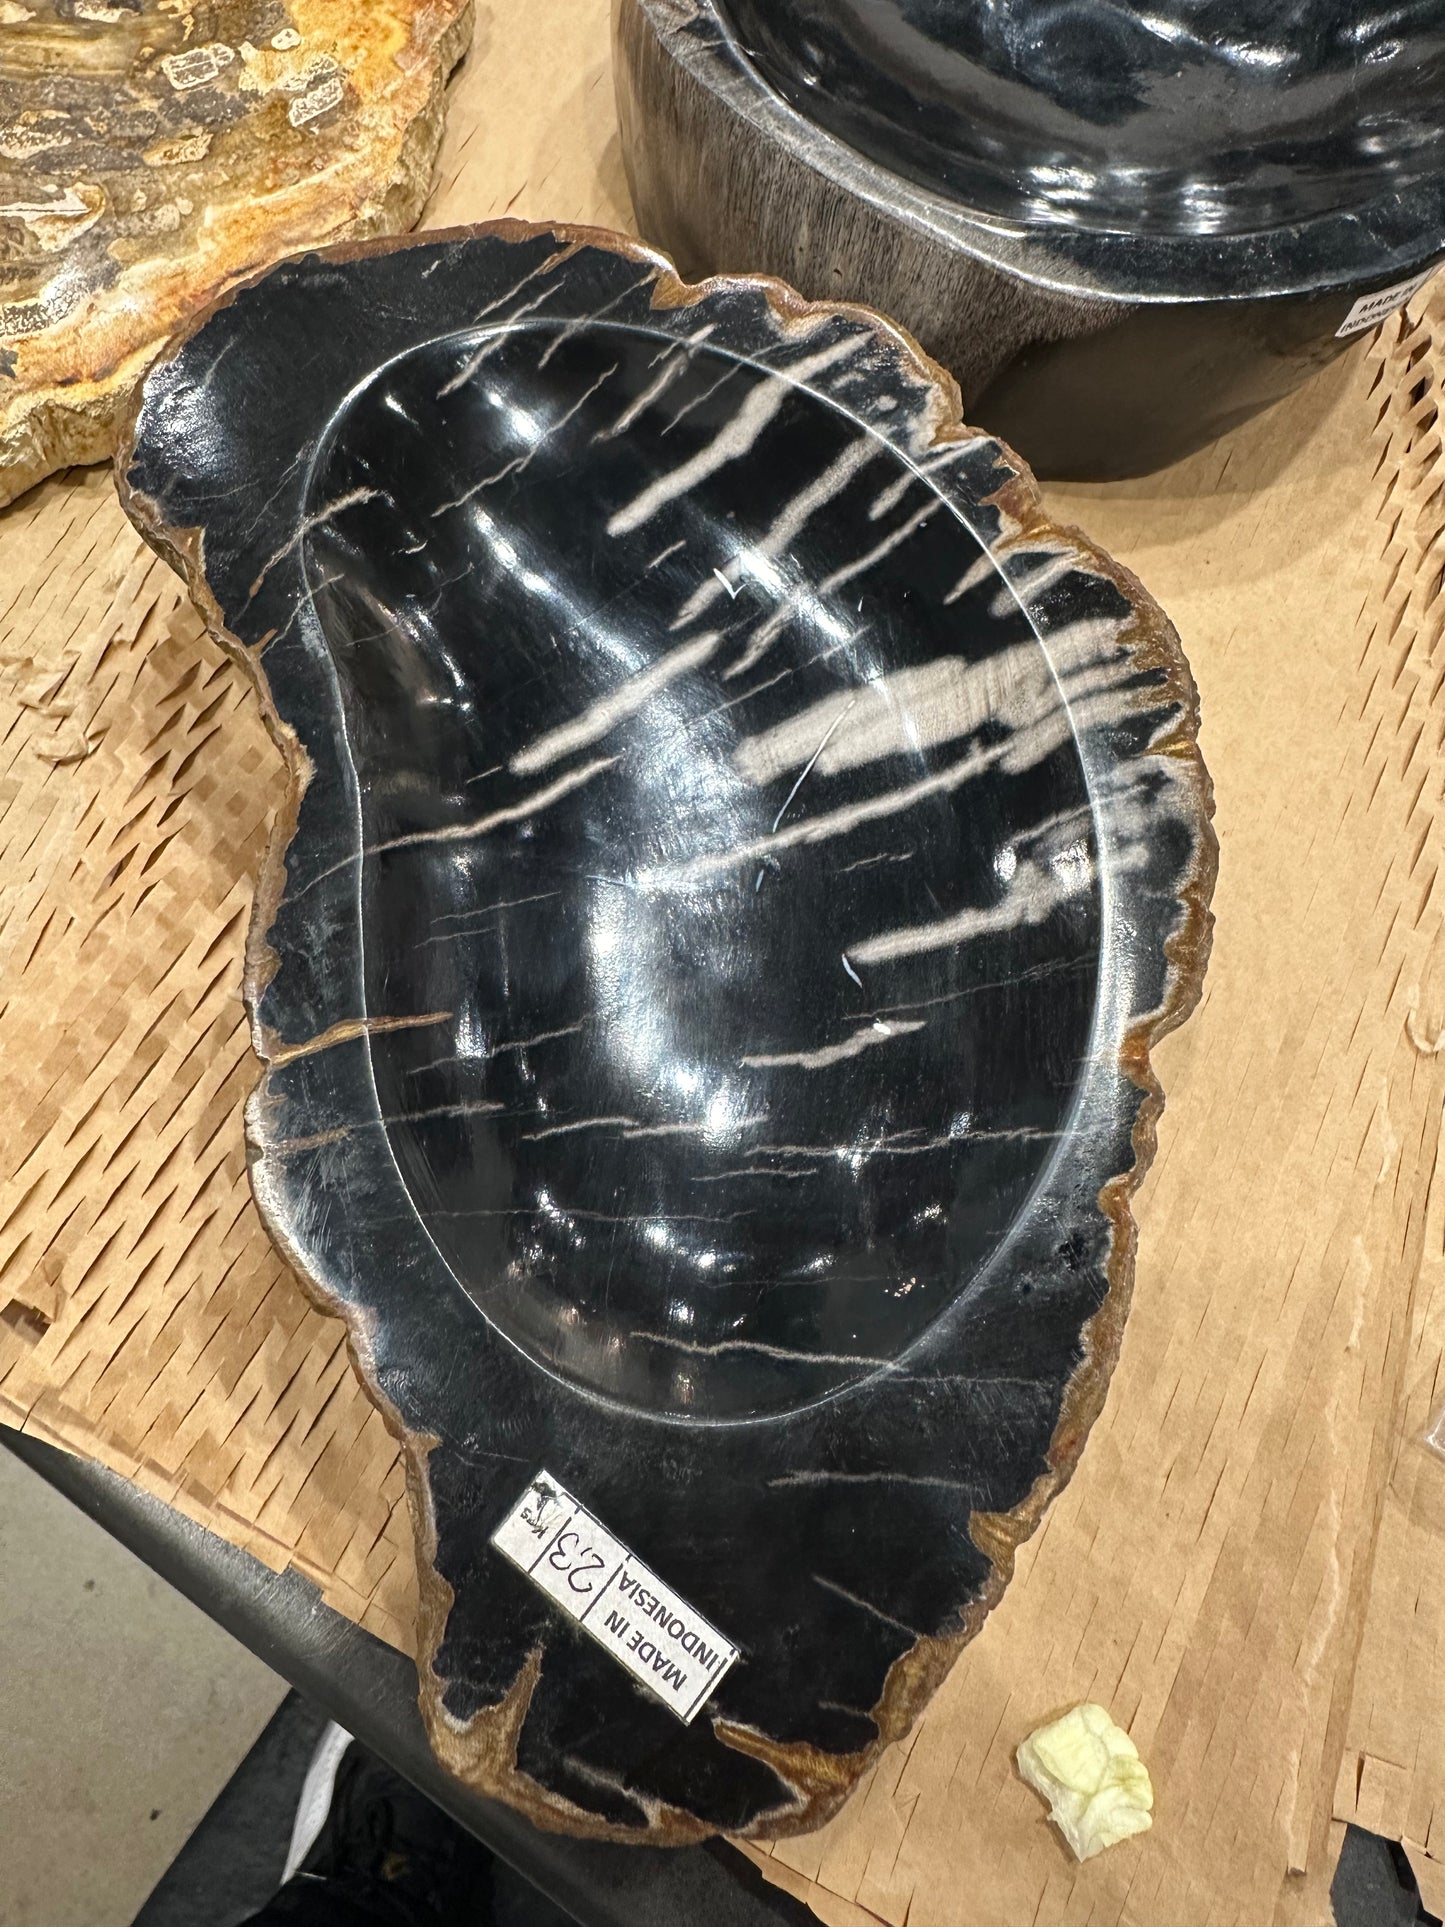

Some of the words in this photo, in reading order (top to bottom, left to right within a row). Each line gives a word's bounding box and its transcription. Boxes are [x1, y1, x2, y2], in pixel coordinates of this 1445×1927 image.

[1340, 296, 1410, 334] INDONE
[1359, 291, 1401, 314] MADE
[549, 1532, 605, 1593] 2,3
[604, 1610, 631, 1639] IN
[617, 1571, 718, 1671] INDONESIA
[626, 1630, 688, 1692] MADE
